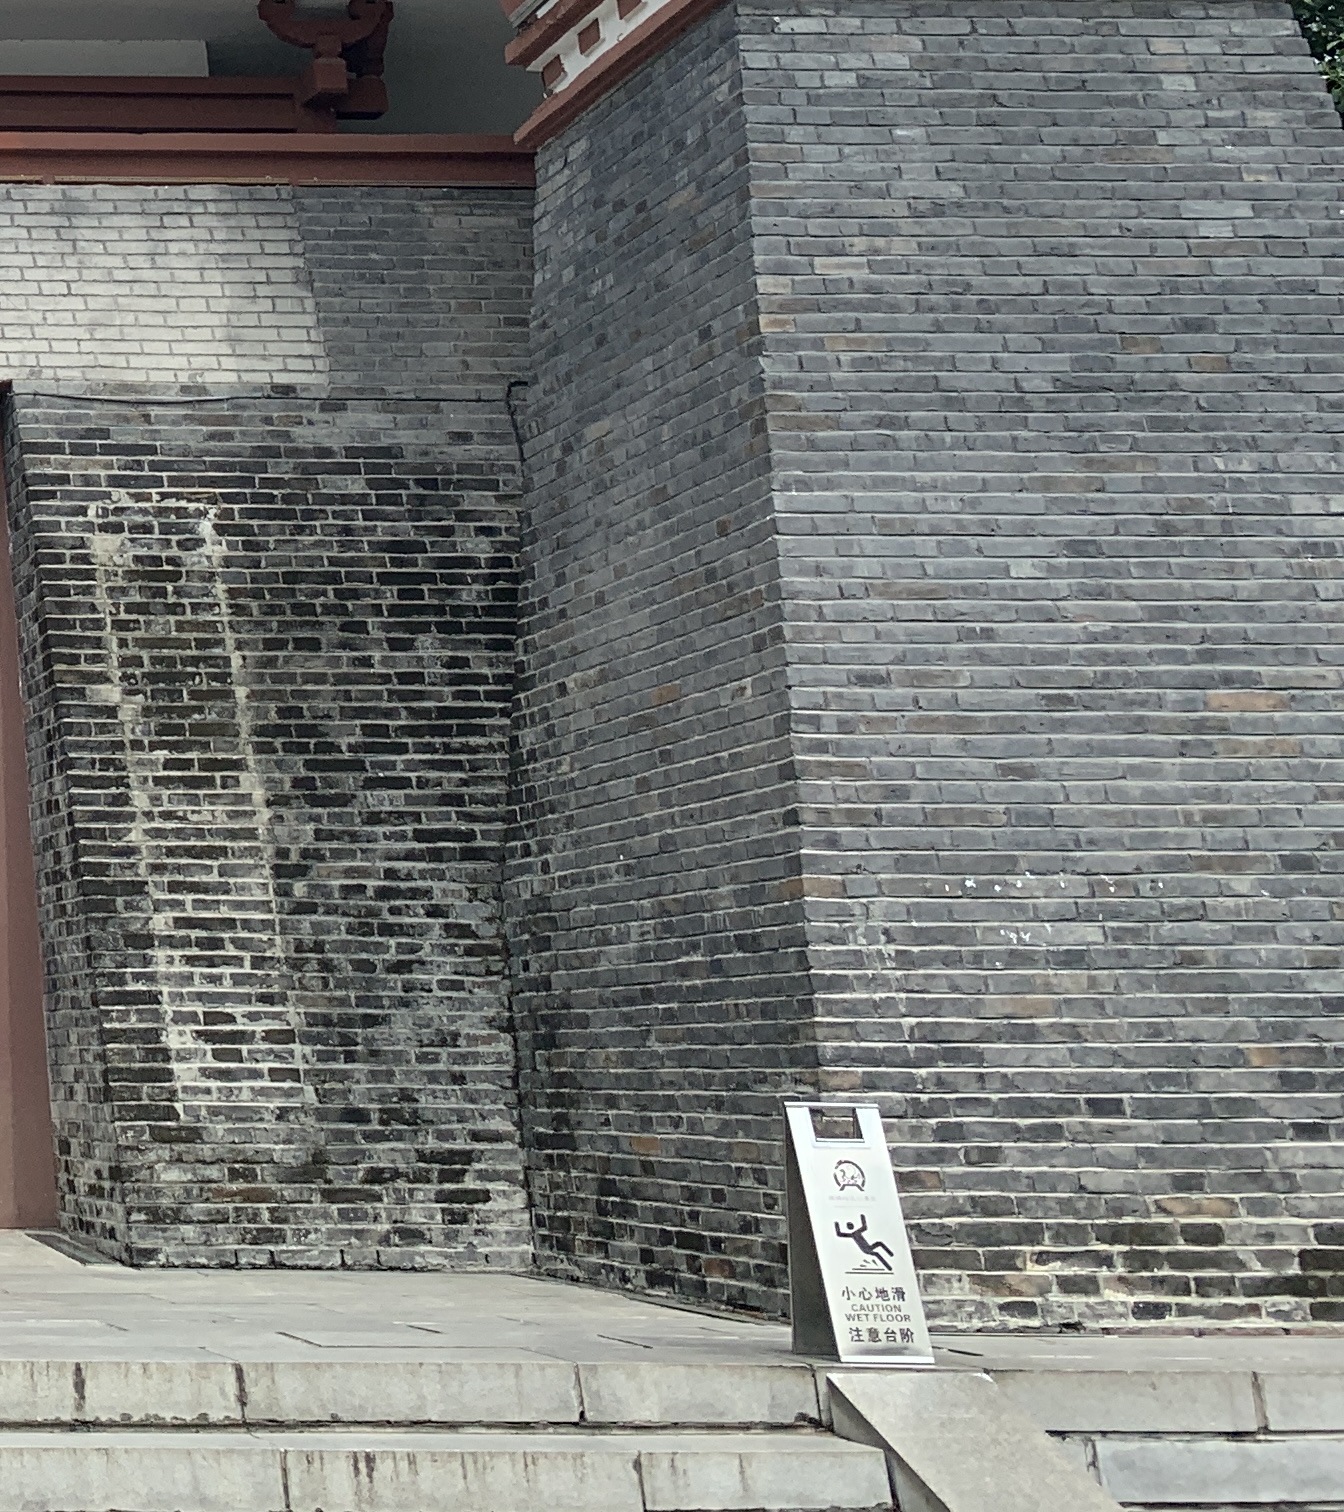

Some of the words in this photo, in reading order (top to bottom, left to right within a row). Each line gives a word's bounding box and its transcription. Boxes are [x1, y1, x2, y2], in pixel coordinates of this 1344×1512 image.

[842, 1286, 906, 1301] 小心地滑
[851, 1304, 902, 1312] CAUTION
[873, 1314, 911, 1322] FLOOR
[849, 1327, 914, 1343] 注意台阶
